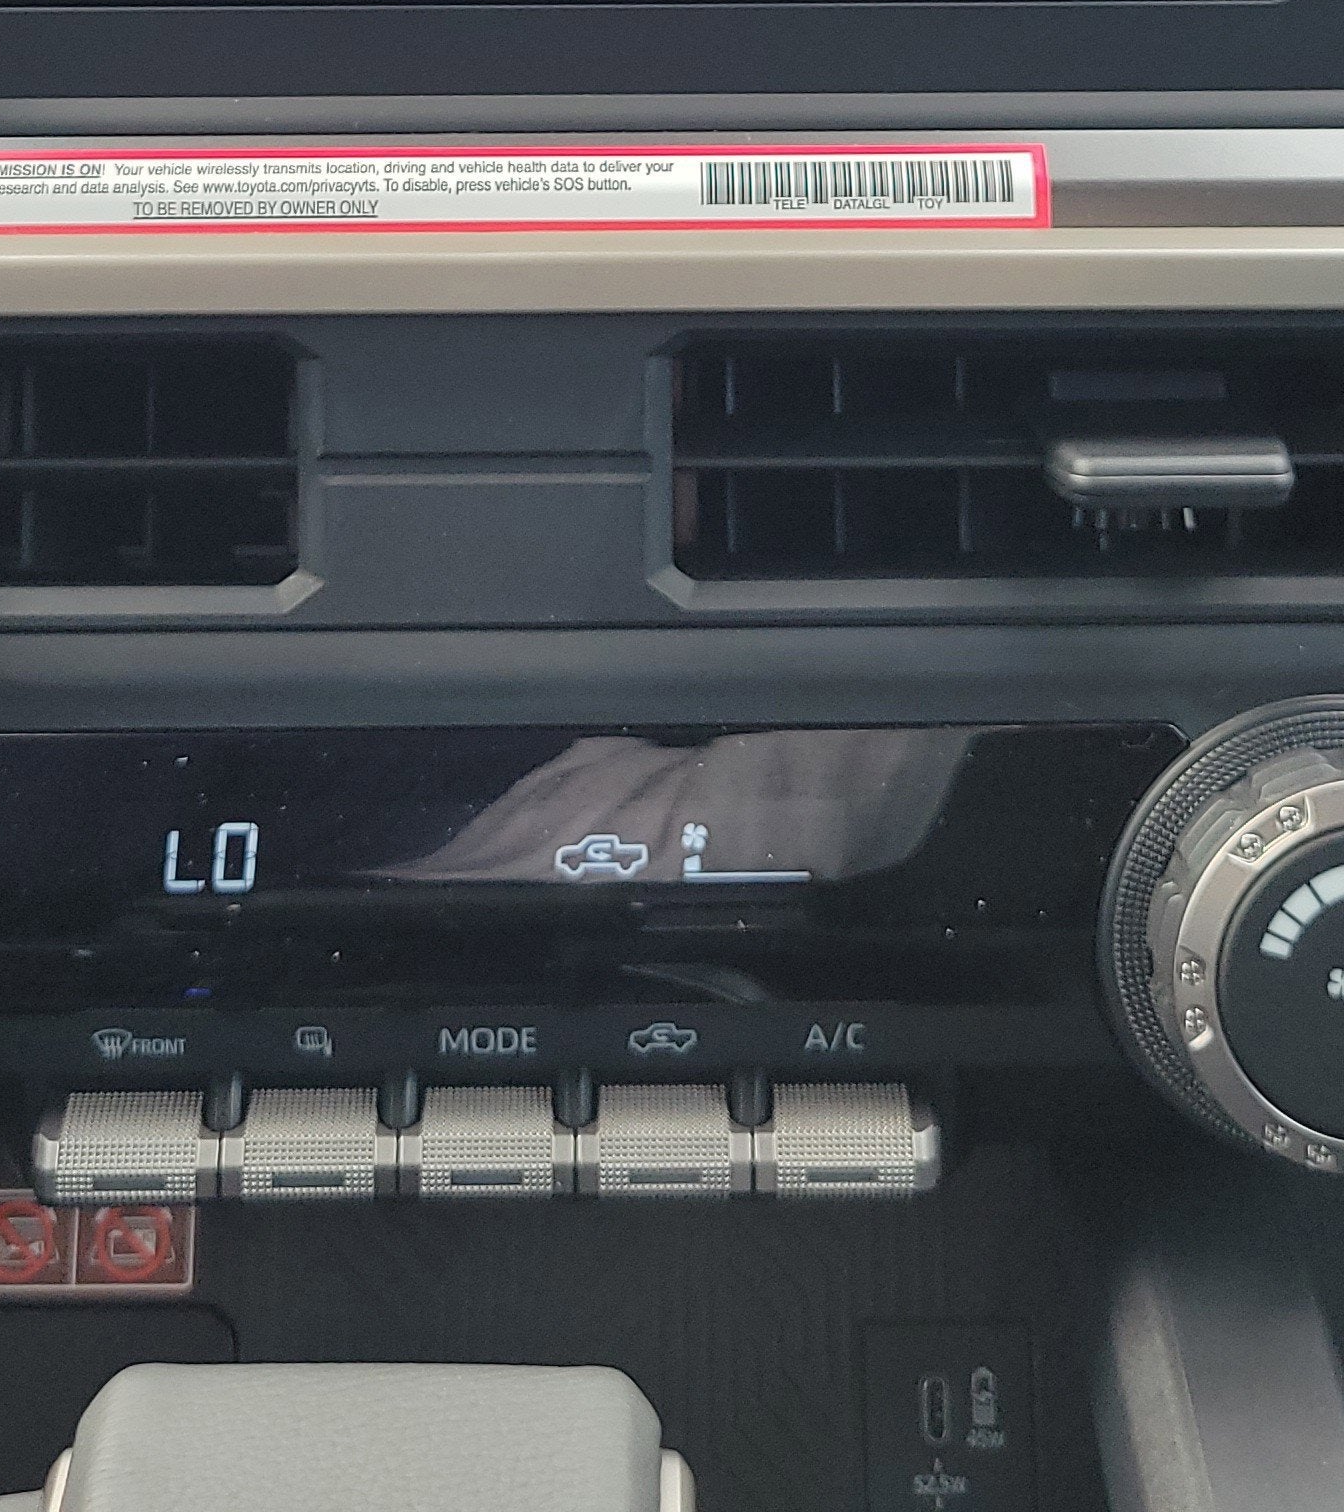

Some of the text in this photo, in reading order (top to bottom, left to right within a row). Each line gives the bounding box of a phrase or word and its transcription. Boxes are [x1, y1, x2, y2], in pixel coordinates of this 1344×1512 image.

[61, 163, 76, 176] IS
[80, 162, 106, 176] ON!
[115, 162, 143, 176] Your
[147, 162, 193, 176] vehicle
[196, 161, 259, 178] wirelessly
[263, 161, 322, 175] transmits
[326, 160, 380, 177] location,
[384, 161, 426, 176] driving
[431, 161, 455, 174] and
[458, 161, 503, 174] vehicle
[507, 160, 547, 174] health
[550, 160, 579, 173] data
[582, 160, 595, 173] to
[599, 159, 642, 173] deliver
[645, 161, 674, 176] your
[53, 181, 77, 194] and
[81, 181, 109, 194] data
[112, 180, 169, 198] analysis.
[173, 180, 199, 194] See
[384, 178, 399, 192] To
[402, 177, 452, 194] disable,
[456, 179, 492, 195] press
[495, 177, 550, 192] vehicle's
[554, 177, 584, 191] SOS
[588, 177, 632, 191] button.
[134, 200, 378, 217] TO BE REMOVED BY OWNER ONLY
[773, 197, 943, 209] TELE DATALGL TOY
[439, 1027, 537, 1054] MODE
[803, 1023, 865, 1051] A/C
[132, 1038, 186, 1056] FRONT
